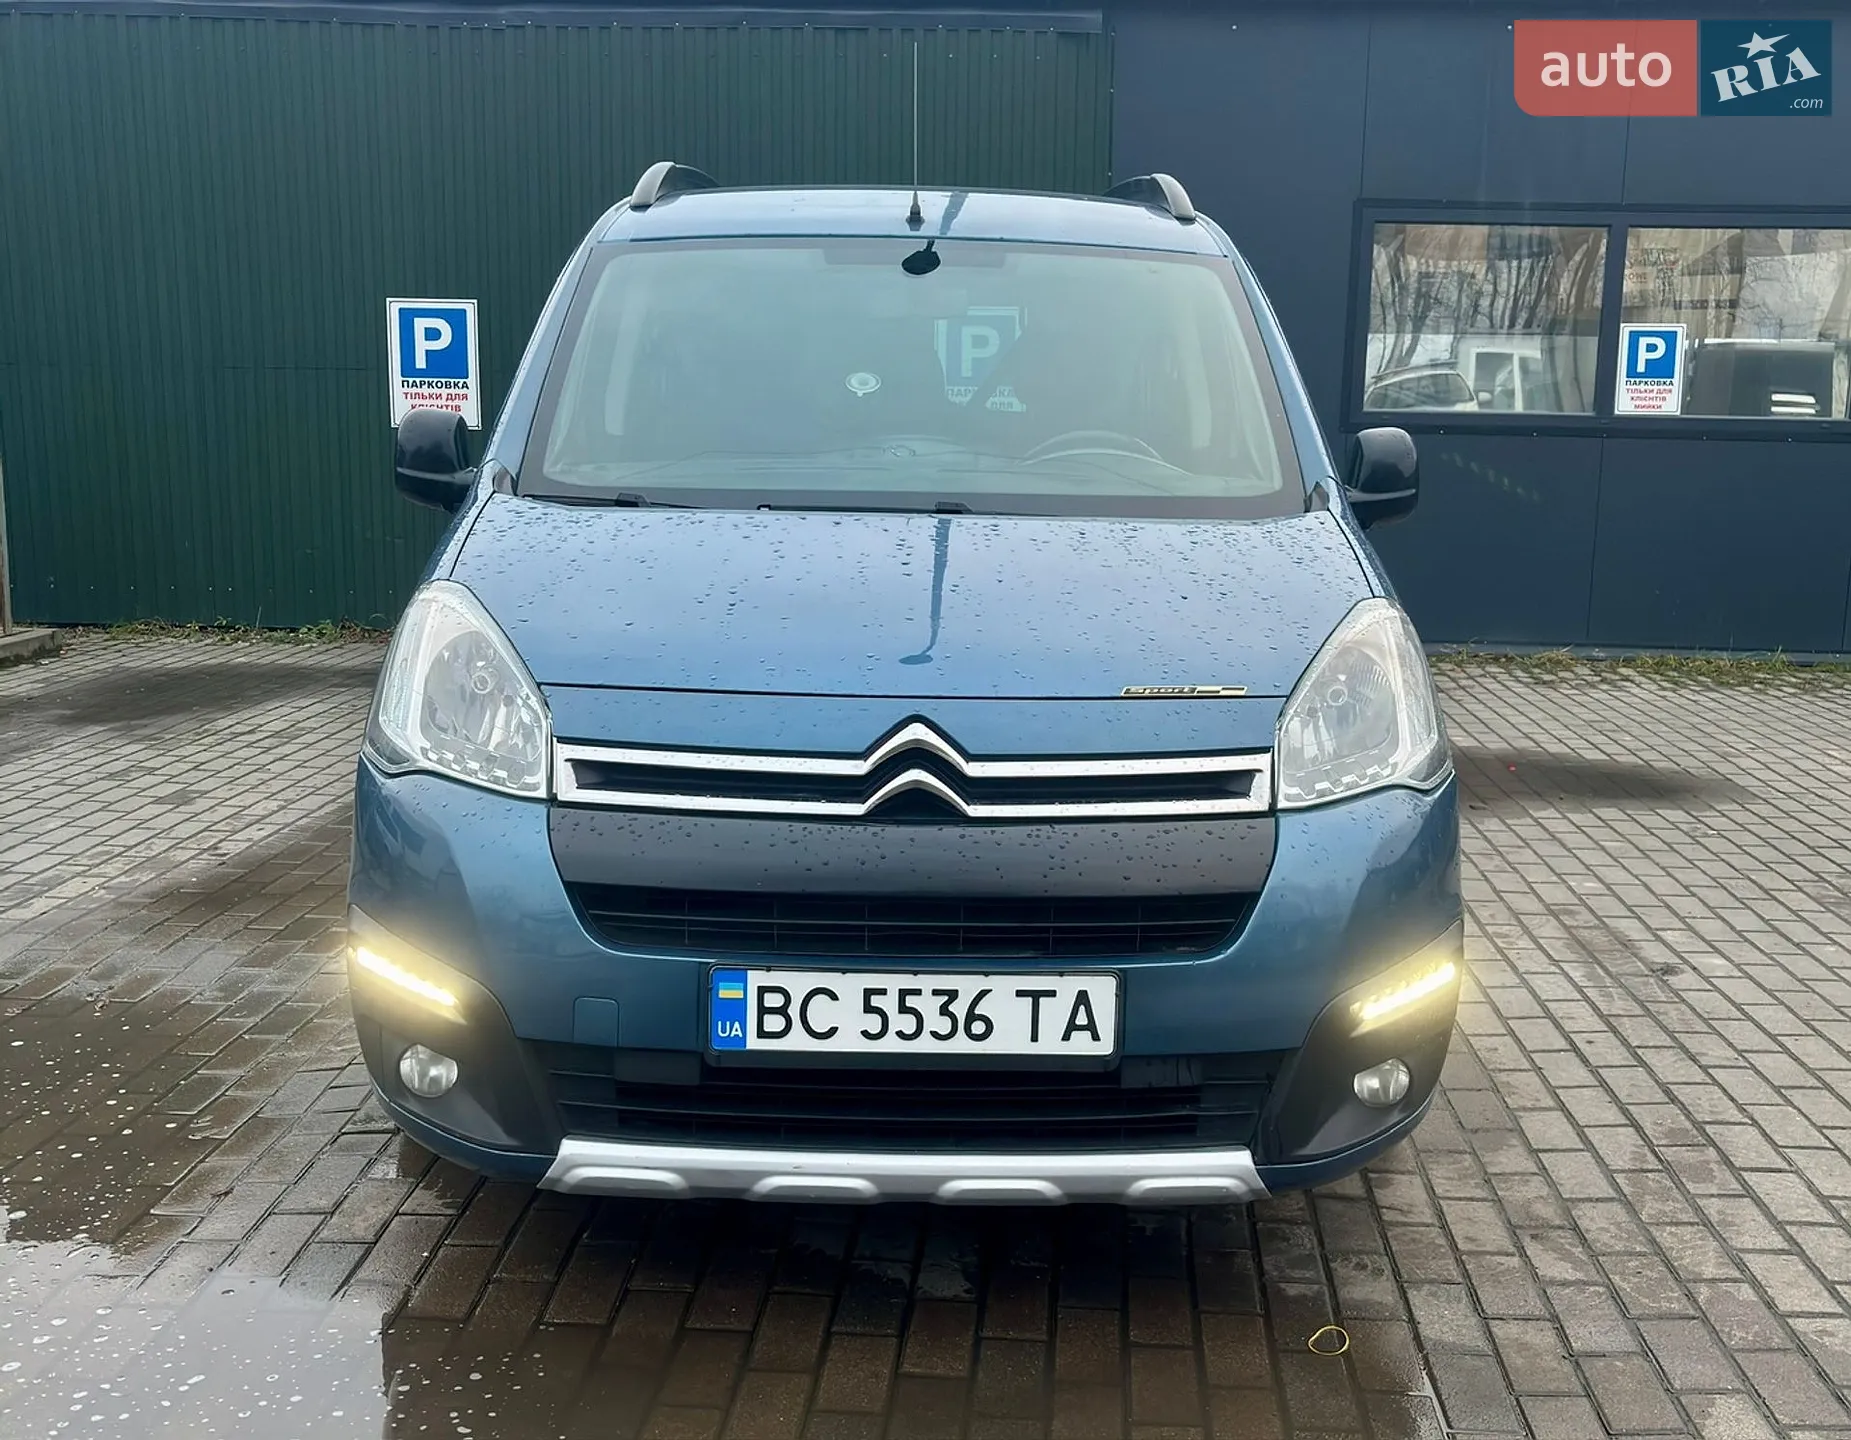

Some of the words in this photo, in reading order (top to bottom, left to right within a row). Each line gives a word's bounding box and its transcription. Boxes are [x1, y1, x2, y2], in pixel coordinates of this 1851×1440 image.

[413, 317, 453, 369] P
[1636, 336, 1667, 373] P
[401, 379, 470, 390] ПАРКОВКА
[403, 391, 443, 400] ТІЛЬКИ
[445, 393, 469, 402] ДЛЯ
[756, 985, 840, 1040] BC
[860, 987, 994, 1042] 5536
[1015, 989, 1102, 1043] TA
[717, 1020, 743, 1038] UA
